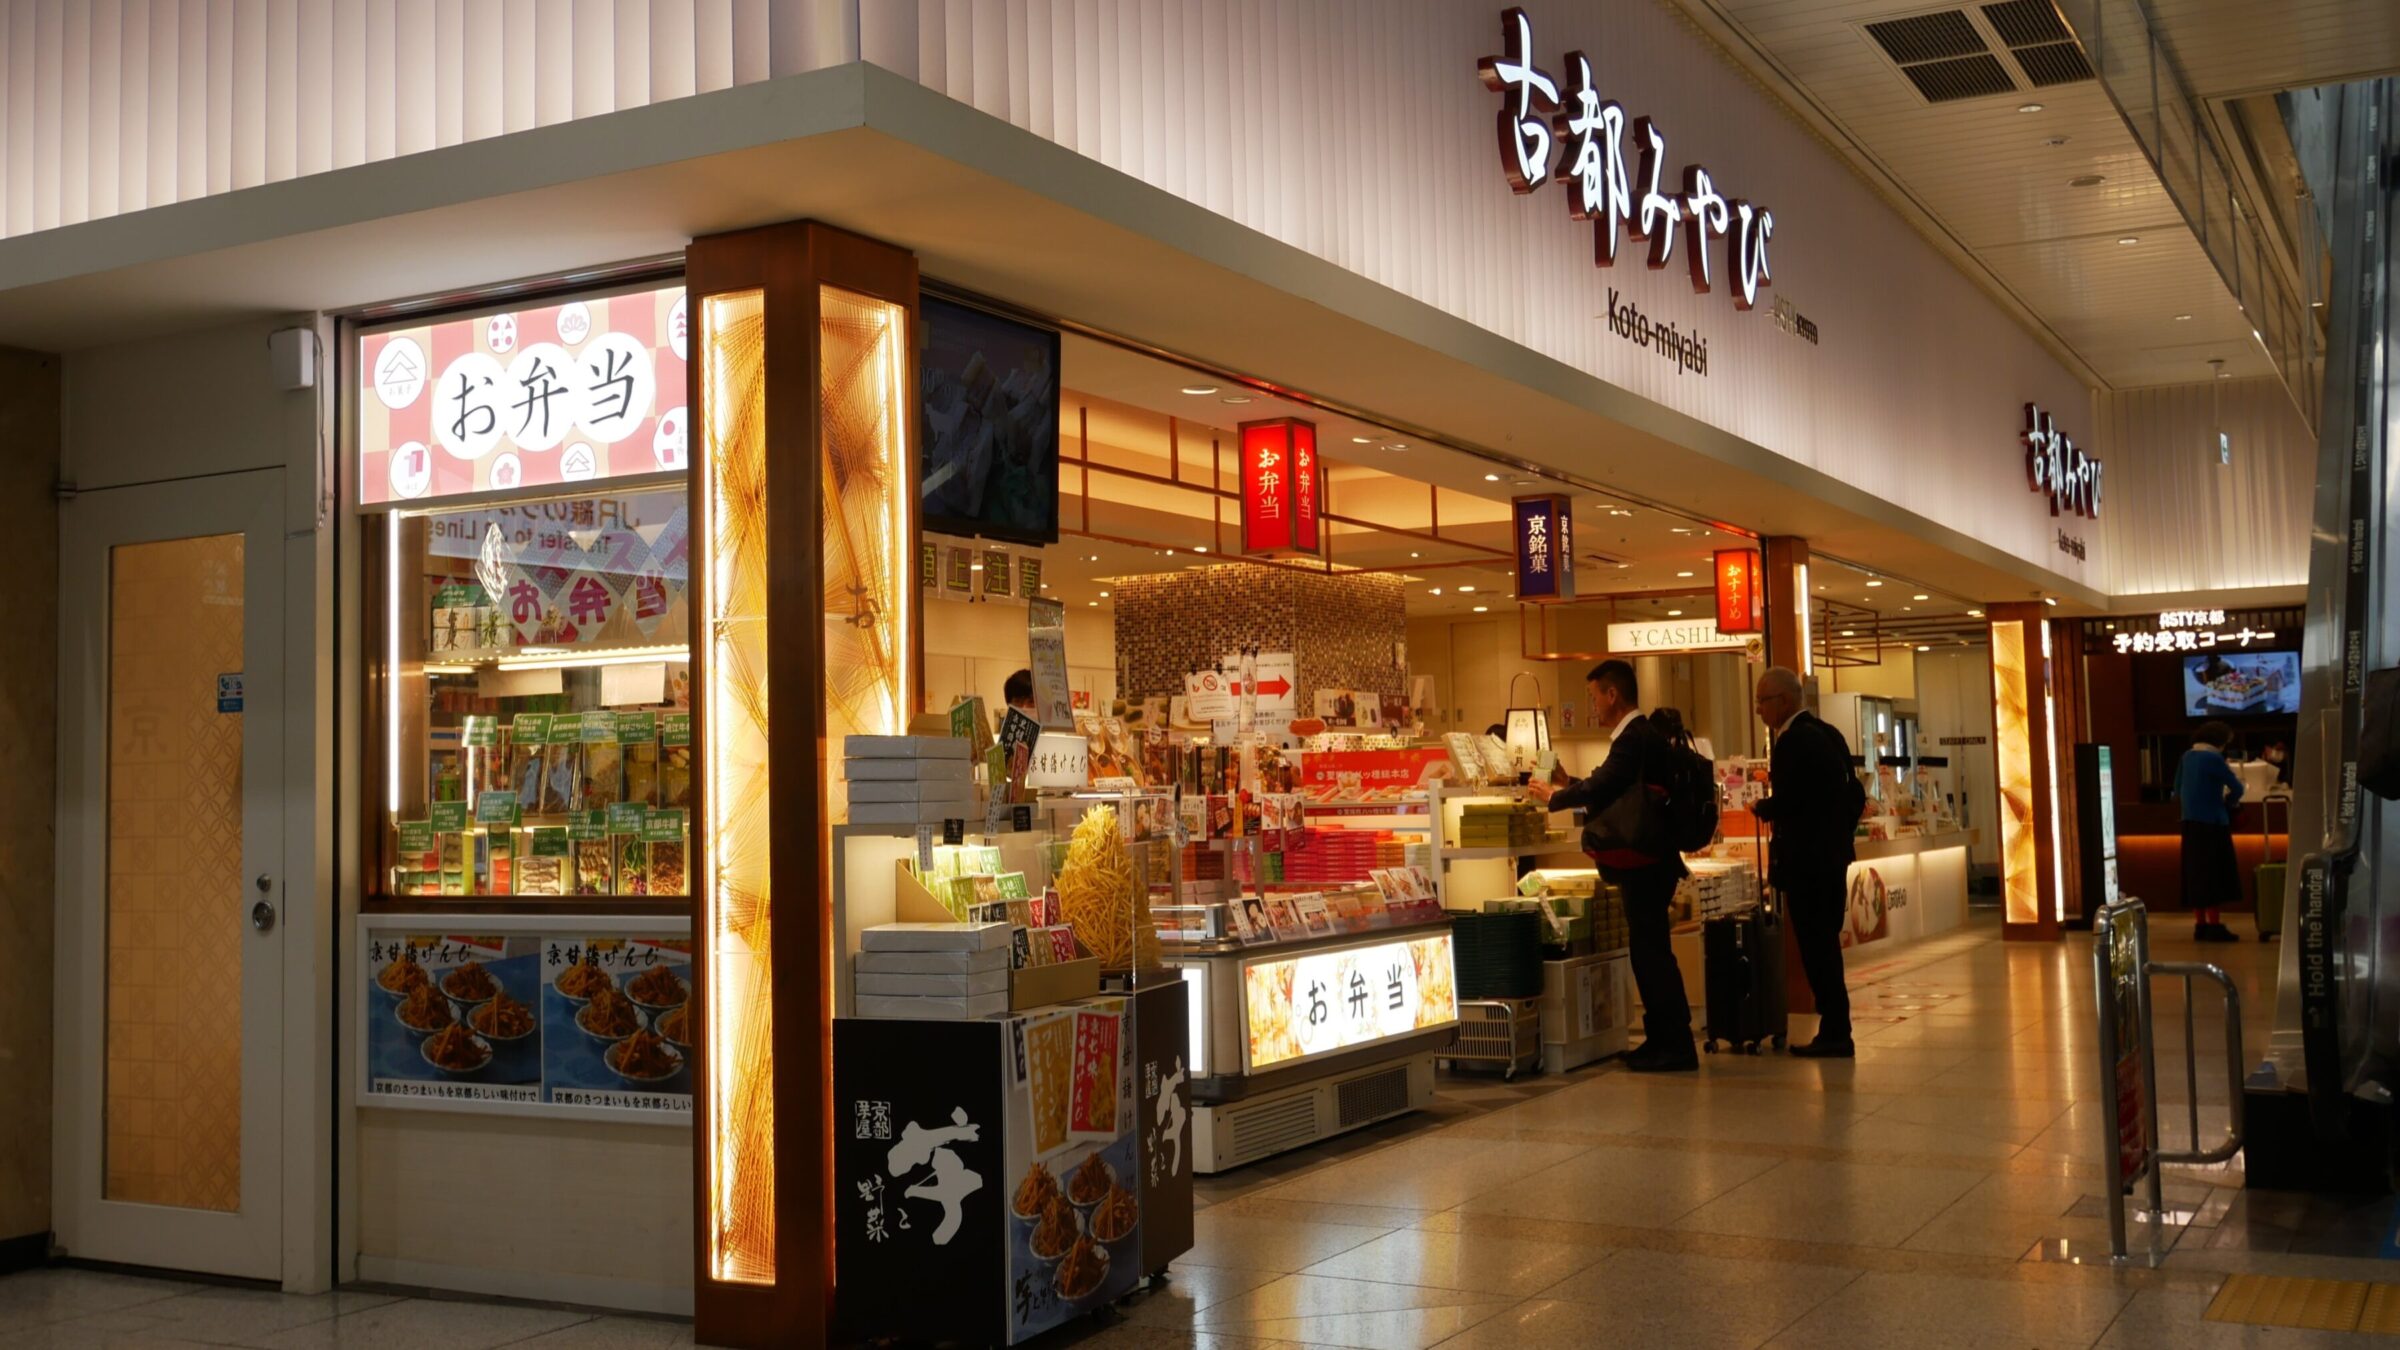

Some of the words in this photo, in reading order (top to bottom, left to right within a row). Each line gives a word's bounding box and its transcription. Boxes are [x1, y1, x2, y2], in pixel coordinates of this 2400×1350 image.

[1485, 10, 1773, 308] 古都みやび
[1607, 287, 1708, 377] Koto-miyabi
[1796, 313, 1818, 345] KYOTO
[451, 348, 635, 442] お弁当
[1257, 448, 1281, 519] お弁当
[1298, 448, 1311, 520] お弁当
[1527, 514, 1548, 574] 京銘菓
[509, 569, 668, 625] お弁当
[1727, 563, 1742, 620] おすすめ
[2159, 609, 2226, 630] ASTY京都
[2112, 626, 2276, 654] 予約受取コーナー
[2305, 868, 2323, 918] handrail
[2306, 922, 2323, 949] the
[1307, 963, 1405, 1027] お弁当
[2306, 954, 2325, 997] Hold
[375, 1082, 537, 1103] 京都のさつまいもを京都らしい味付けで
